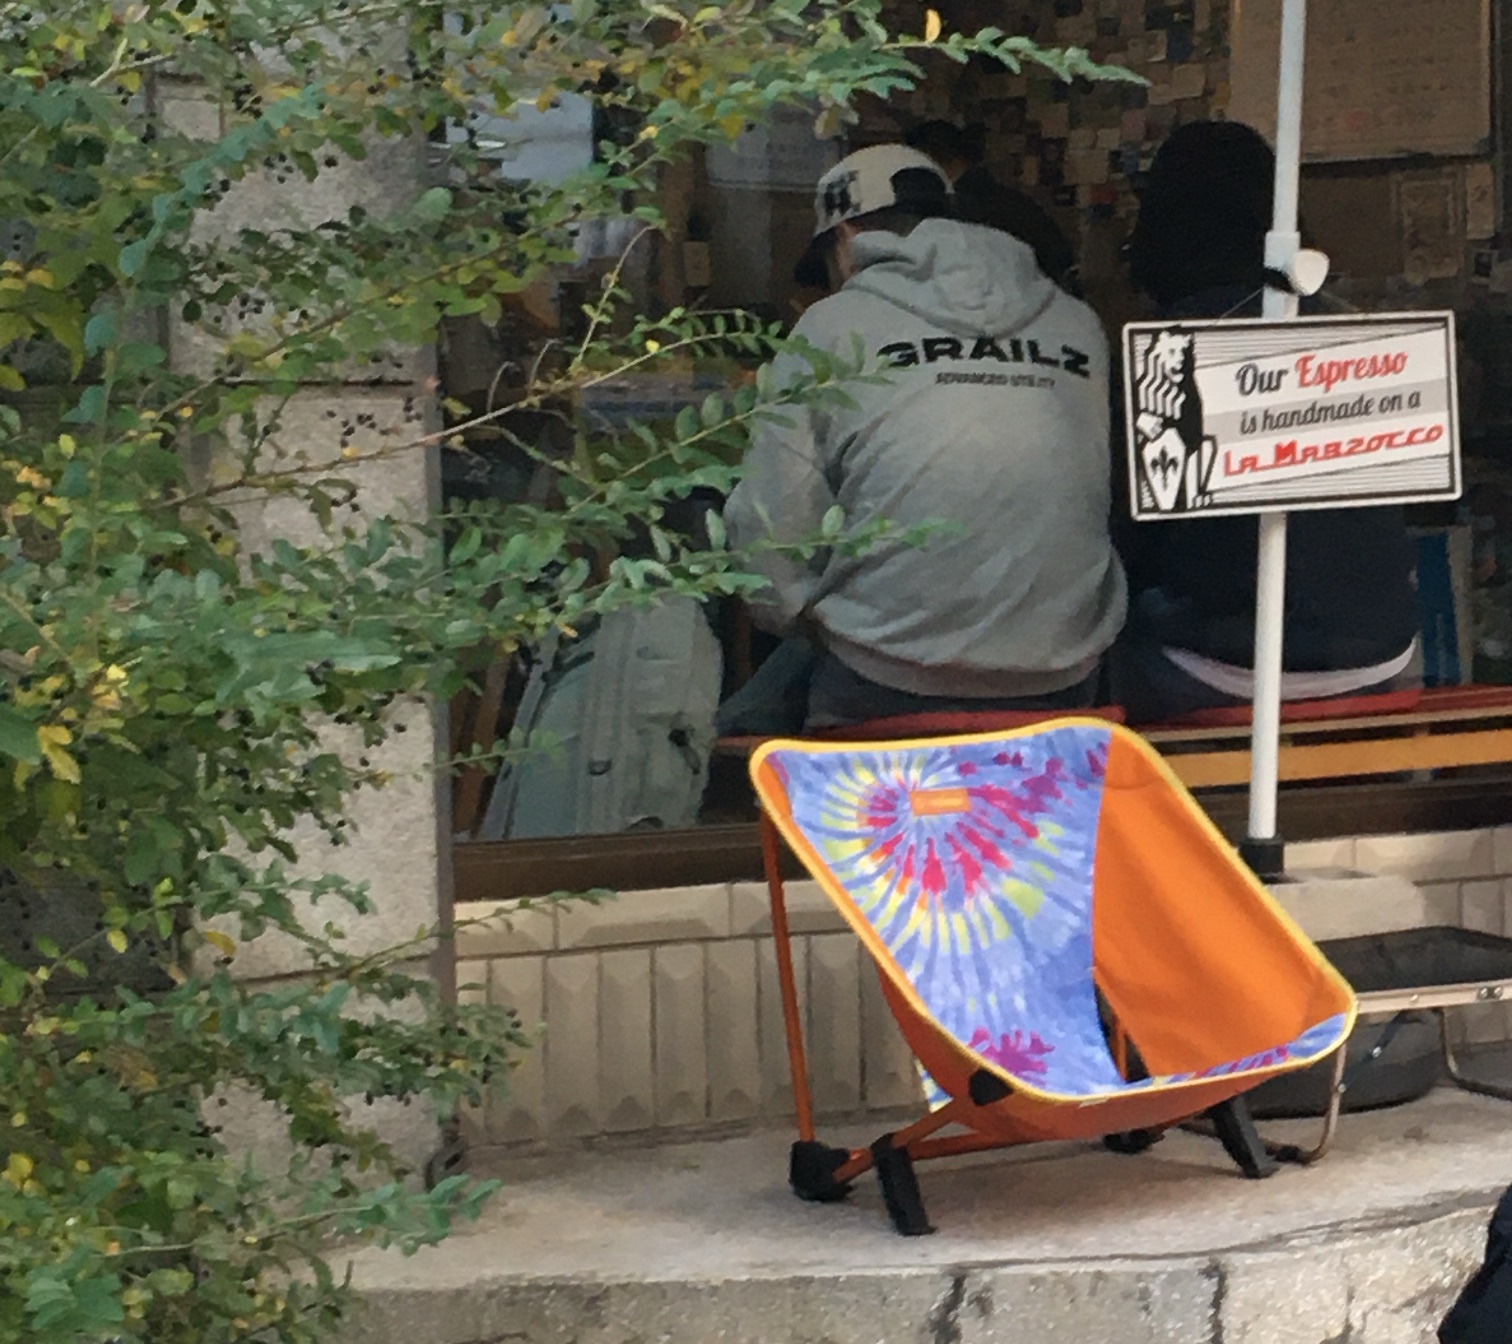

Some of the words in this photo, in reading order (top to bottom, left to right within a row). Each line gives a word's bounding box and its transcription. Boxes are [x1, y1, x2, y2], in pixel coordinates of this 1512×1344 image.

[1236, 363, 1288, 395] Our
[1295, 351, 1408, 393] Espresso
[1240, 412, 1257, 435] is
[1262, 394, 1374, 431] handmade
[1378, 396, 1403, 414] on
[1408, 390, 1422, 409] a
